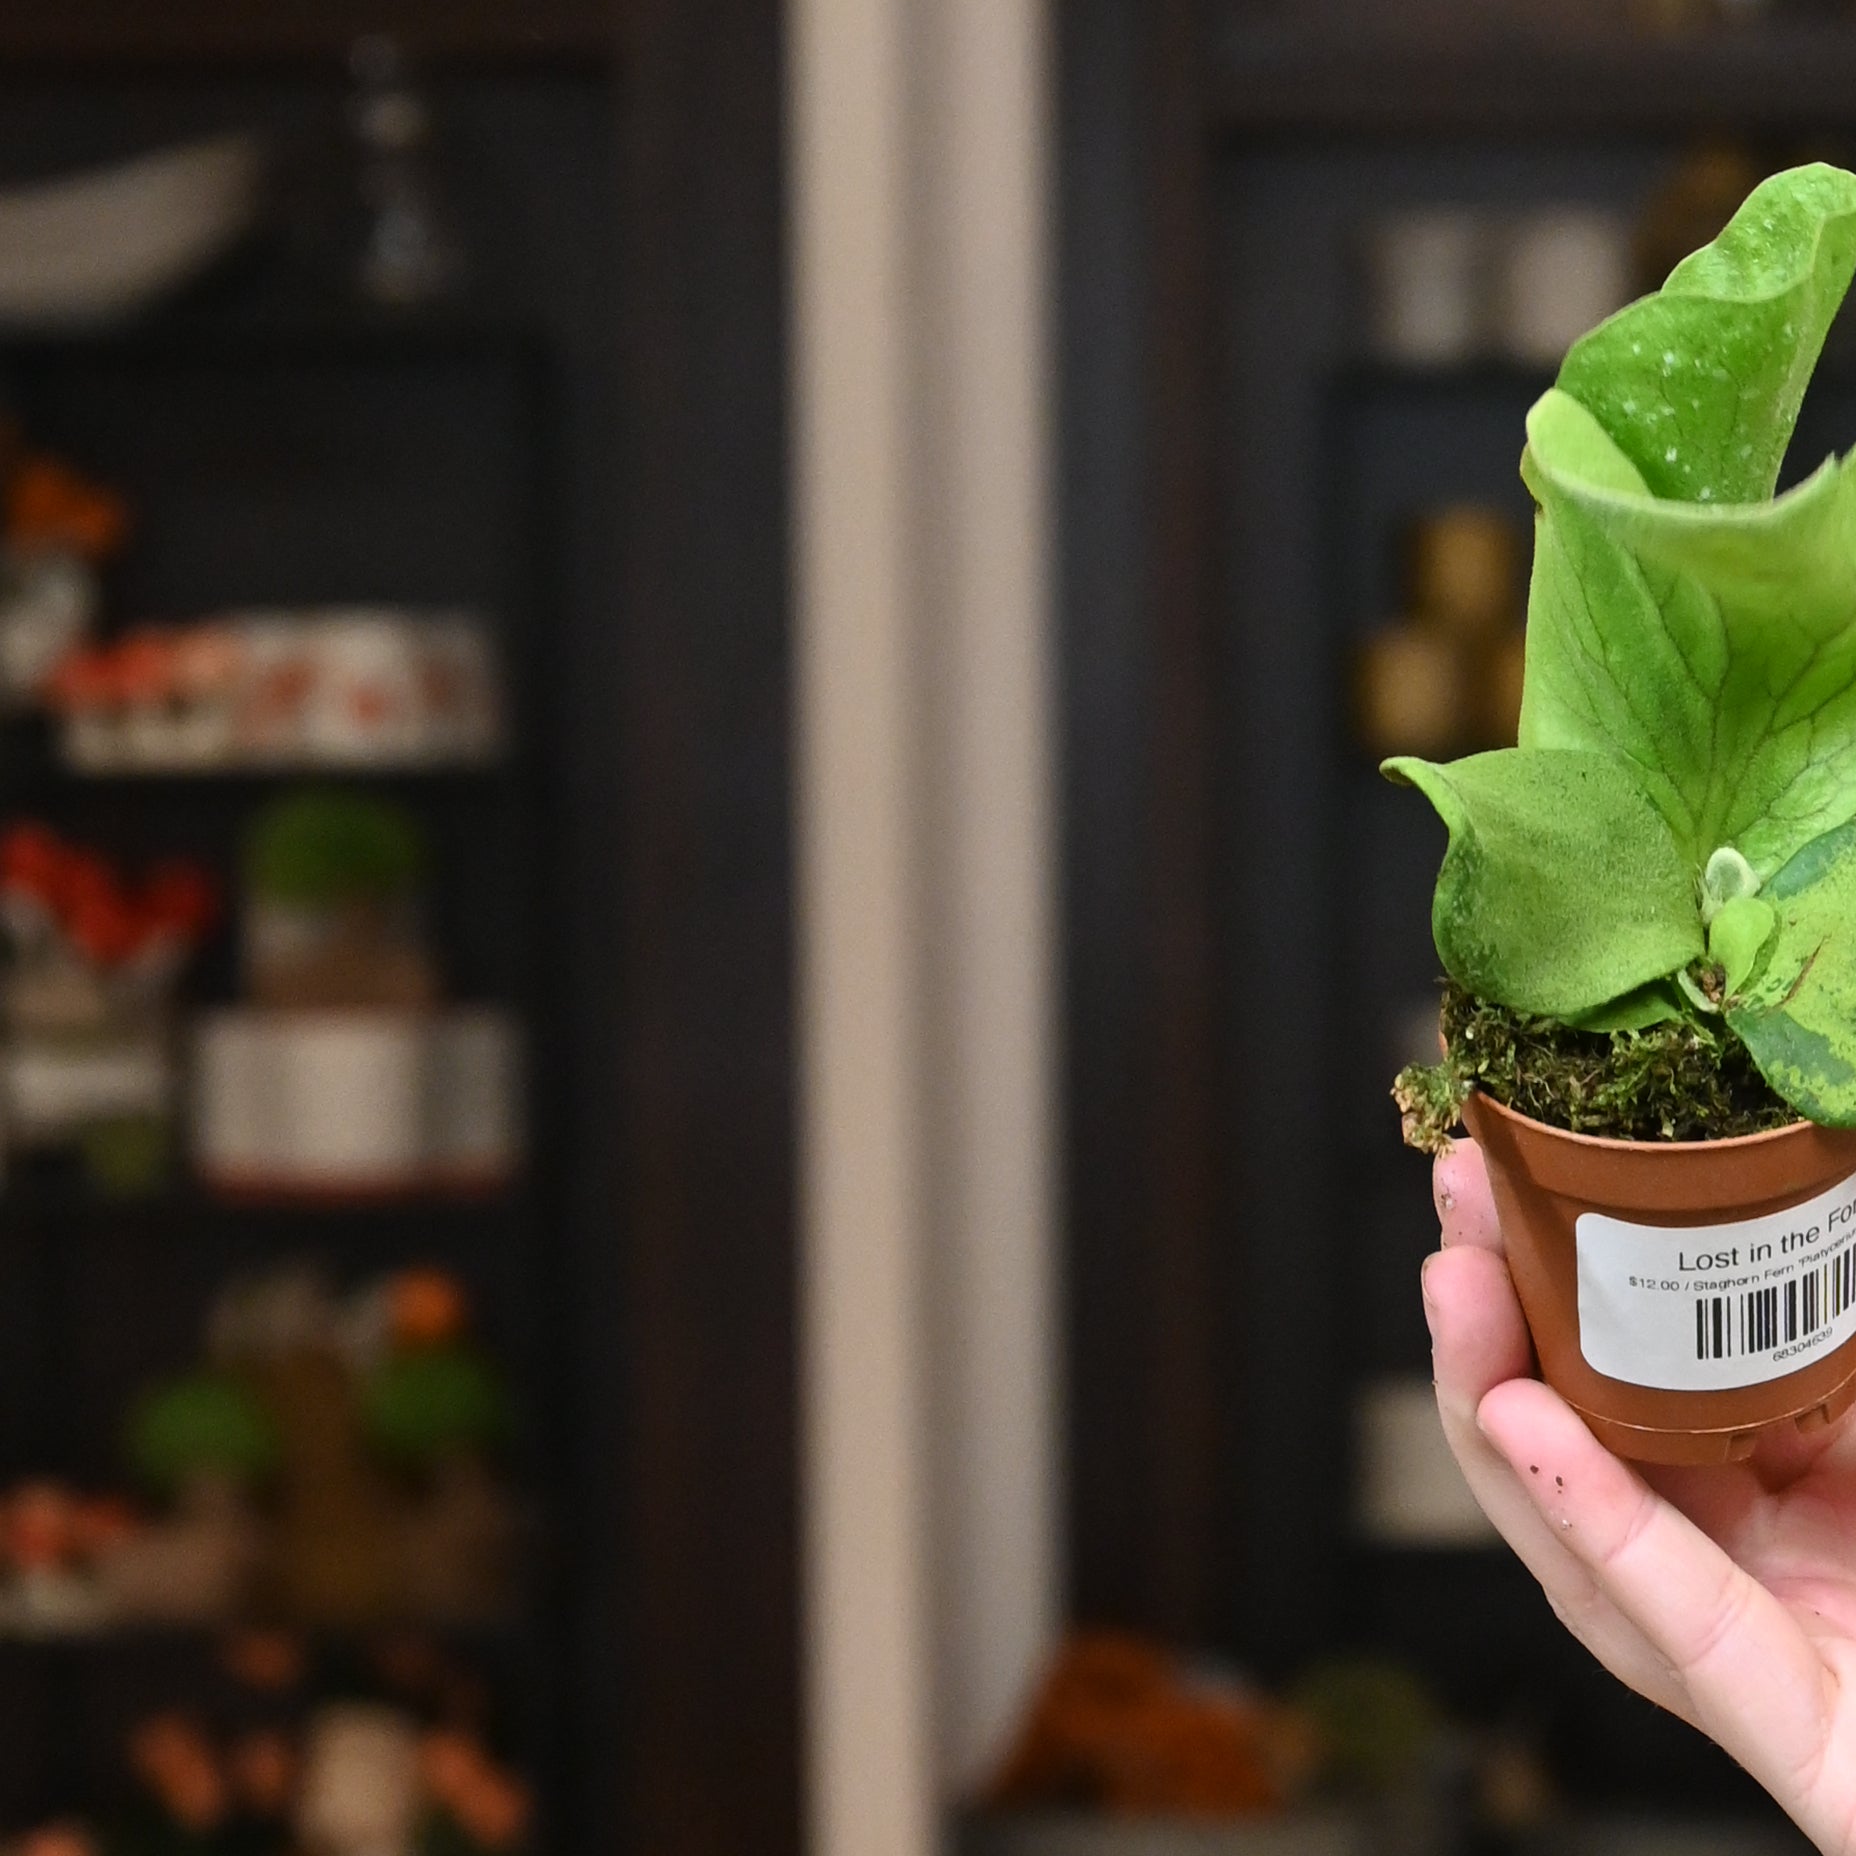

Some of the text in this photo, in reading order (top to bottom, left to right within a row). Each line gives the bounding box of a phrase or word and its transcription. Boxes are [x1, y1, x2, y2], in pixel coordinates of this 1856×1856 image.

[1679, 1246, 1739, 1271] Lost
[1750, 1242, 1772, 1263] in
[1780, 1225, 1820, 1254] the
[1629, 1275, 1680, 1292] $12.00
[1693, 1274, 1760, 1292] Staghorn
[1764, 1264, 1794, 1280] Fern
[1772, 1326, 1833, 1362] 68304639
